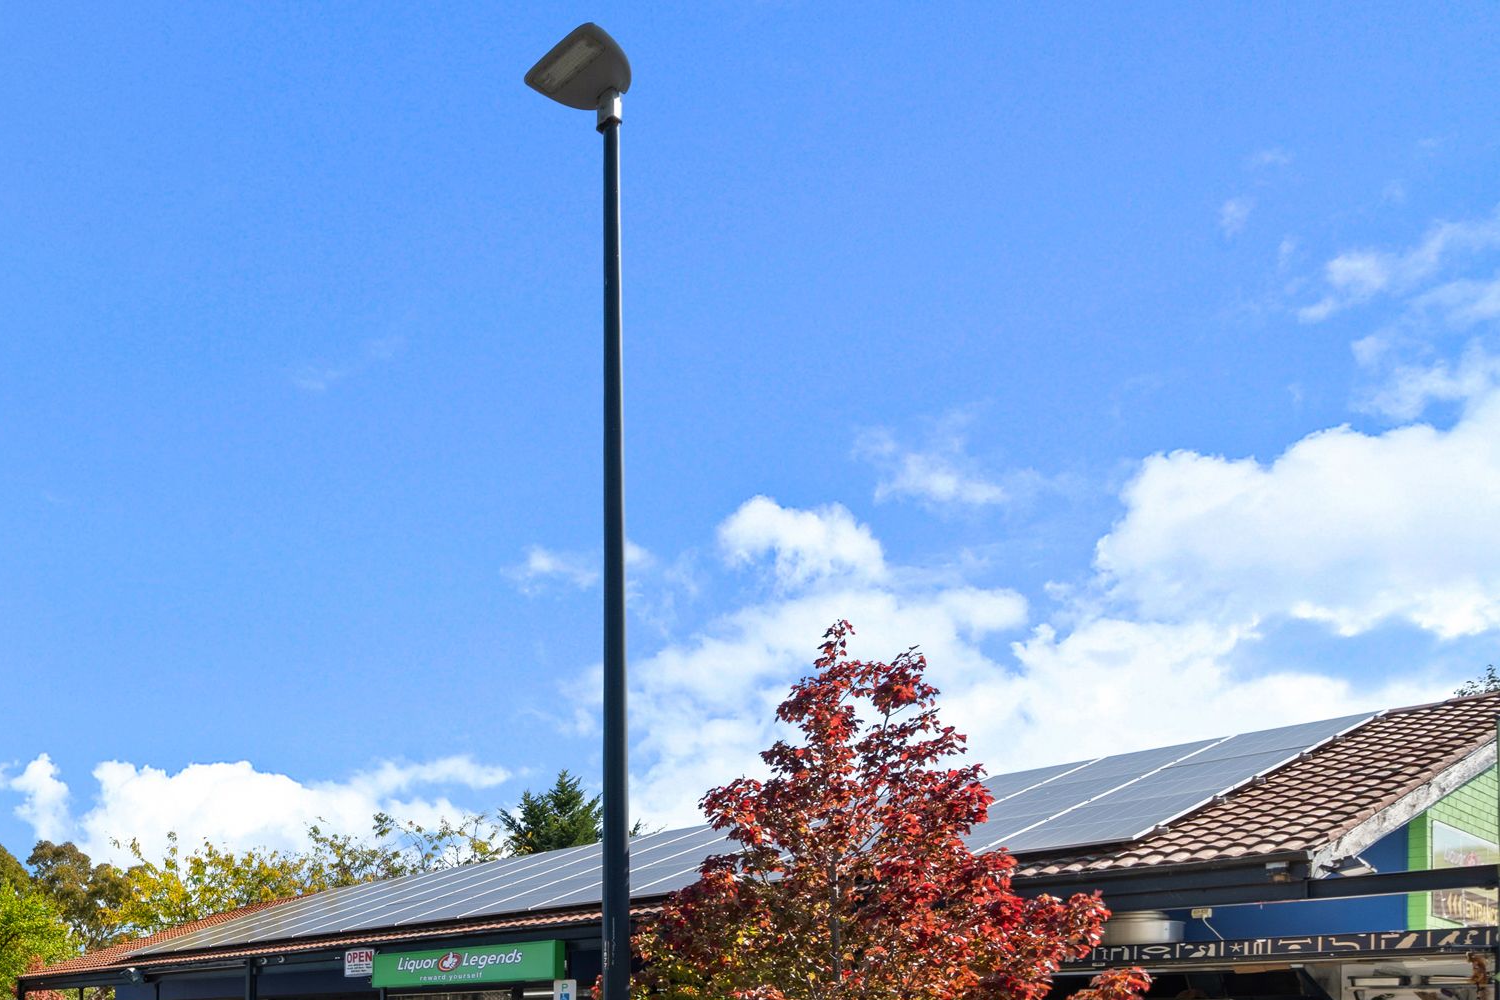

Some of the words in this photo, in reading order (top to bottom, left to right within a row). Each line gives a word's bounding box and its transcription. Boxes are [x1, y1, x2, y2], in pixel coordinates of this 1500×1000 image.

[346, 950, 373, 964] OPEN
[397, 957, 438, 973] Liquor
[462, 949, 523, 969] Legends
[449, 972, 483, 981] yourself
[561, 983, 569, 992] P
